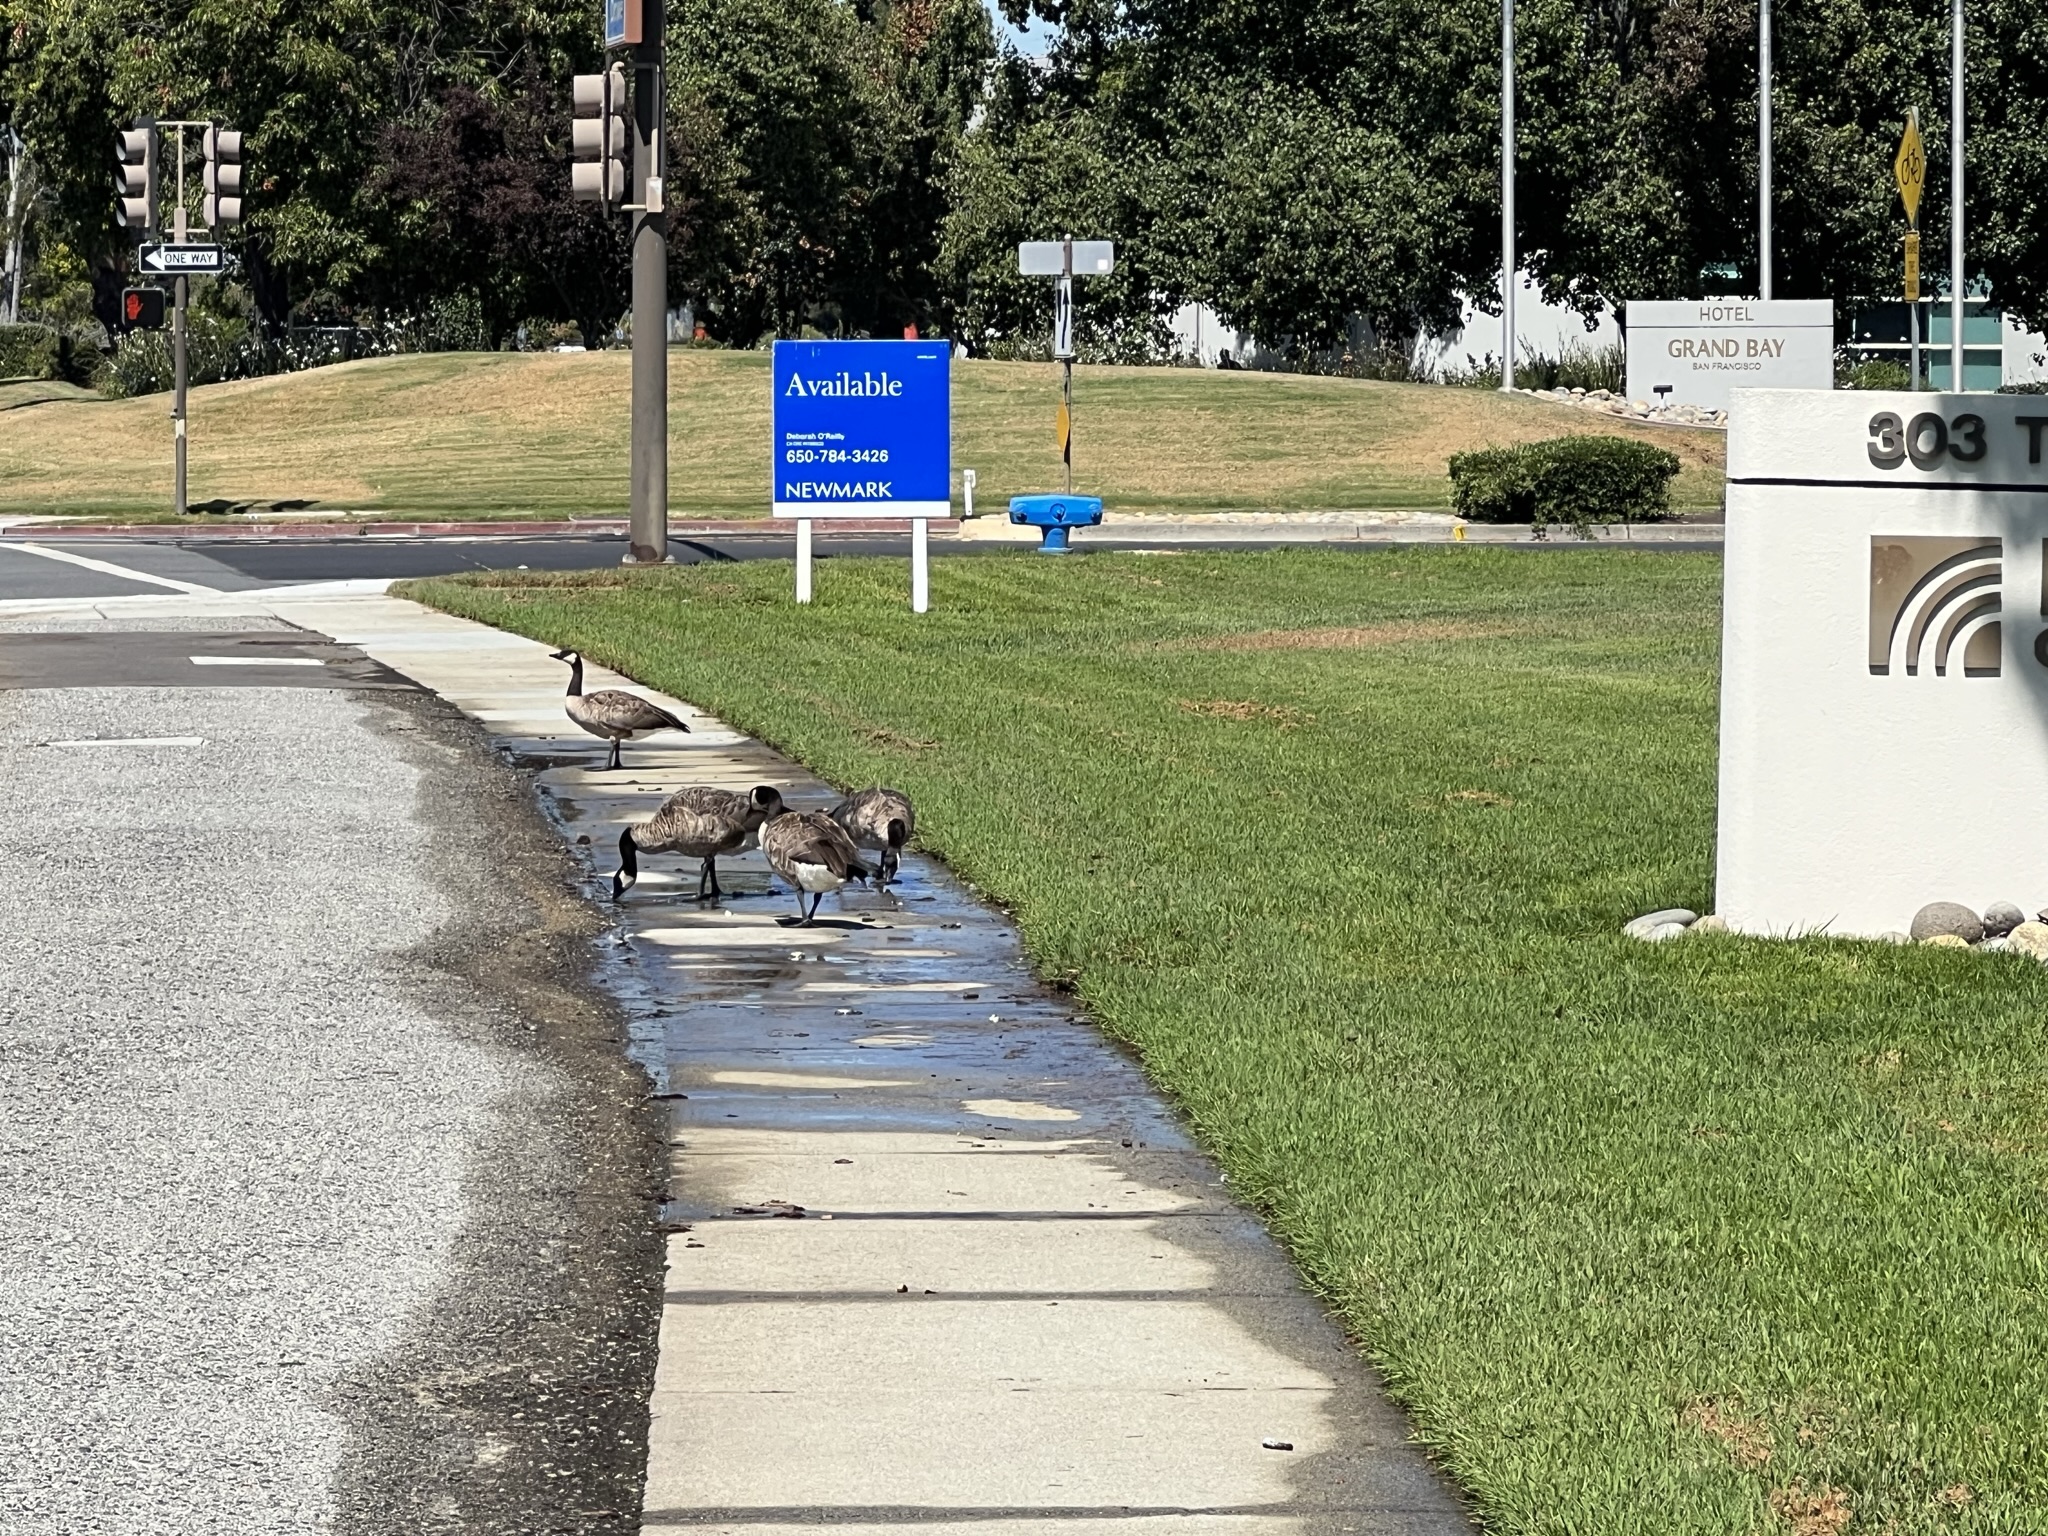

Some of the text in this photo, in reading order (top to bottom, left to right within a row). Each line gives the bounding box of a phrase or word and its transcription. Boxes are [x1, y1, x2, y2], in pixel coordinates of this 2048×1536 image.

[165, 253, 213, 263] ONE WAY
[1700, 306, 1755, 321] HOTEL
[1668, 339, 1786, 358] GRAND BAY
[1692, 362, 1762, 371] SAN FRANCISCO
[785, 371, 903, 397] Available
[1867, 411, 1987, 465] 303
[786, 449, 889, 464] 650-784-3426
[785, 481, 893, 499] NEWMARK
